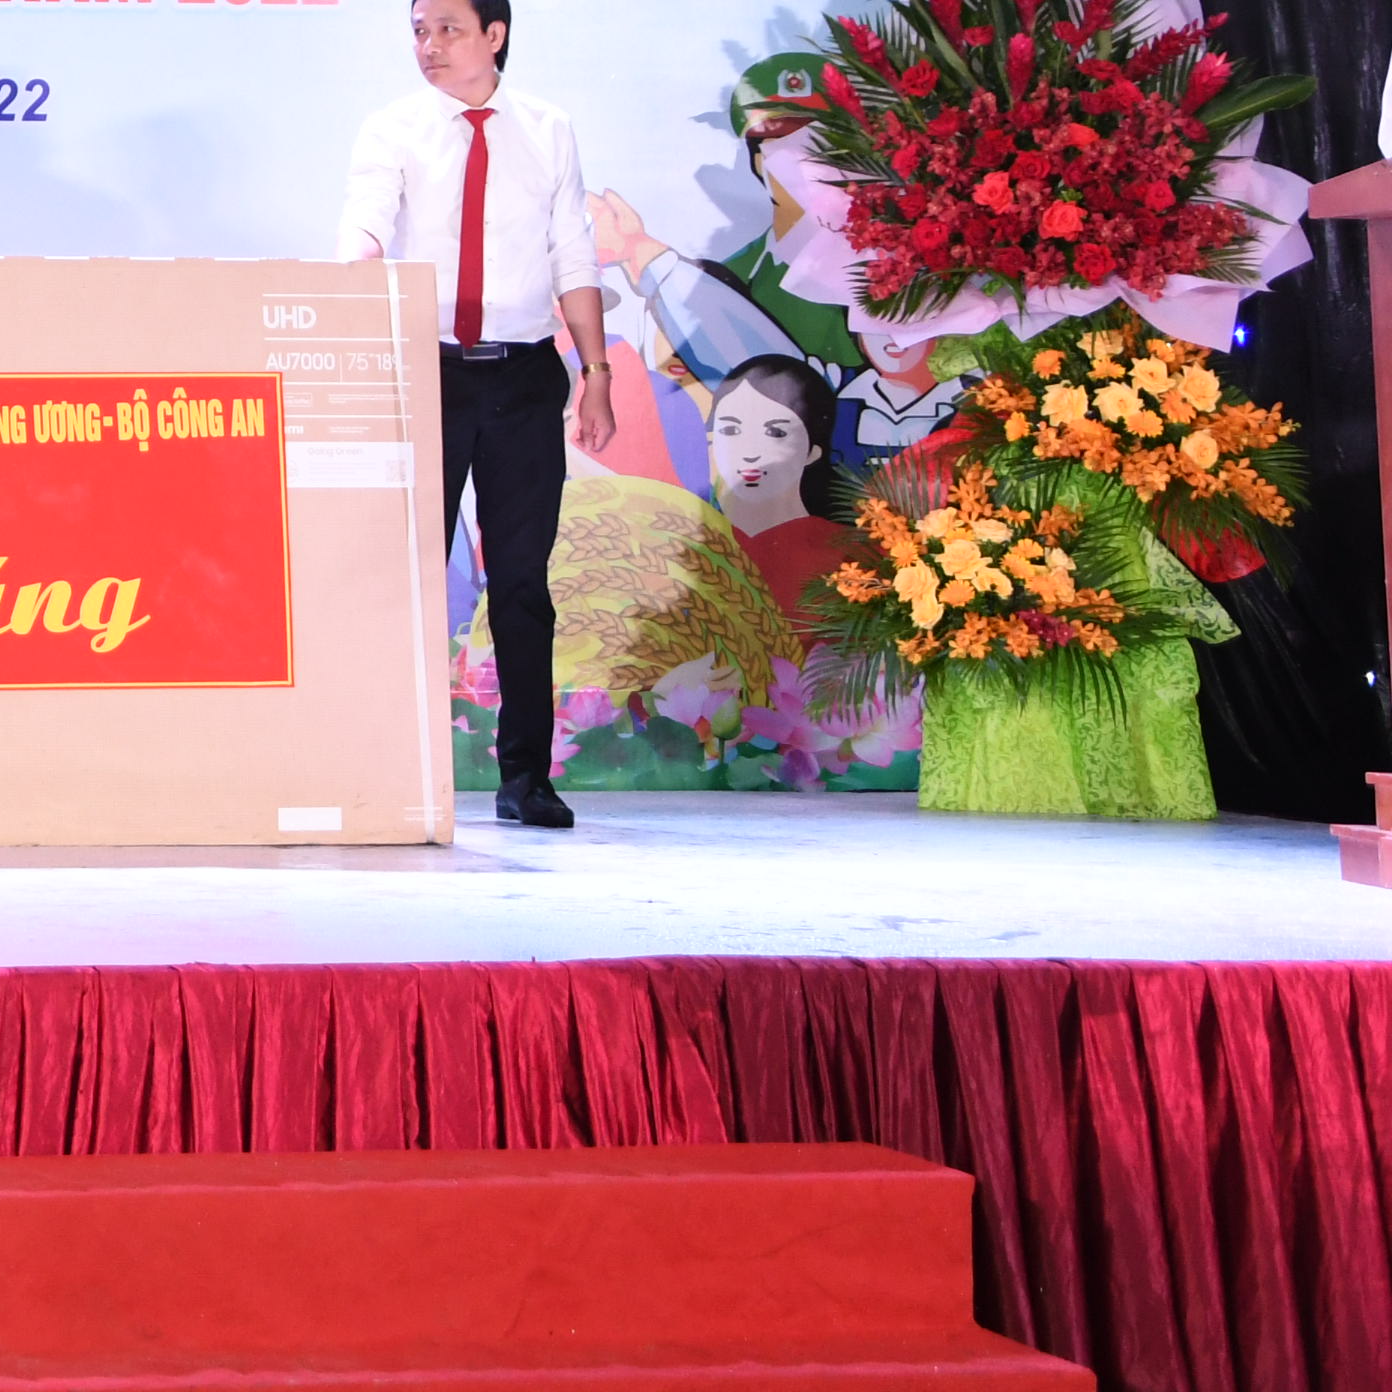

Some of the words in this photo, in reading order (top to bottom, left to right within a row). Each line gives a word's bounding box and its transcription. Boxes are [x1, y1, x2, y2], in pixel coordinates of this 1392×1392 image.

[262, 305, 317, 329] UHD
[265, 351, 336, 371] AU7000
[156, 386, 225, 440] CÔNG
[230, 397, 266, 438] AN
